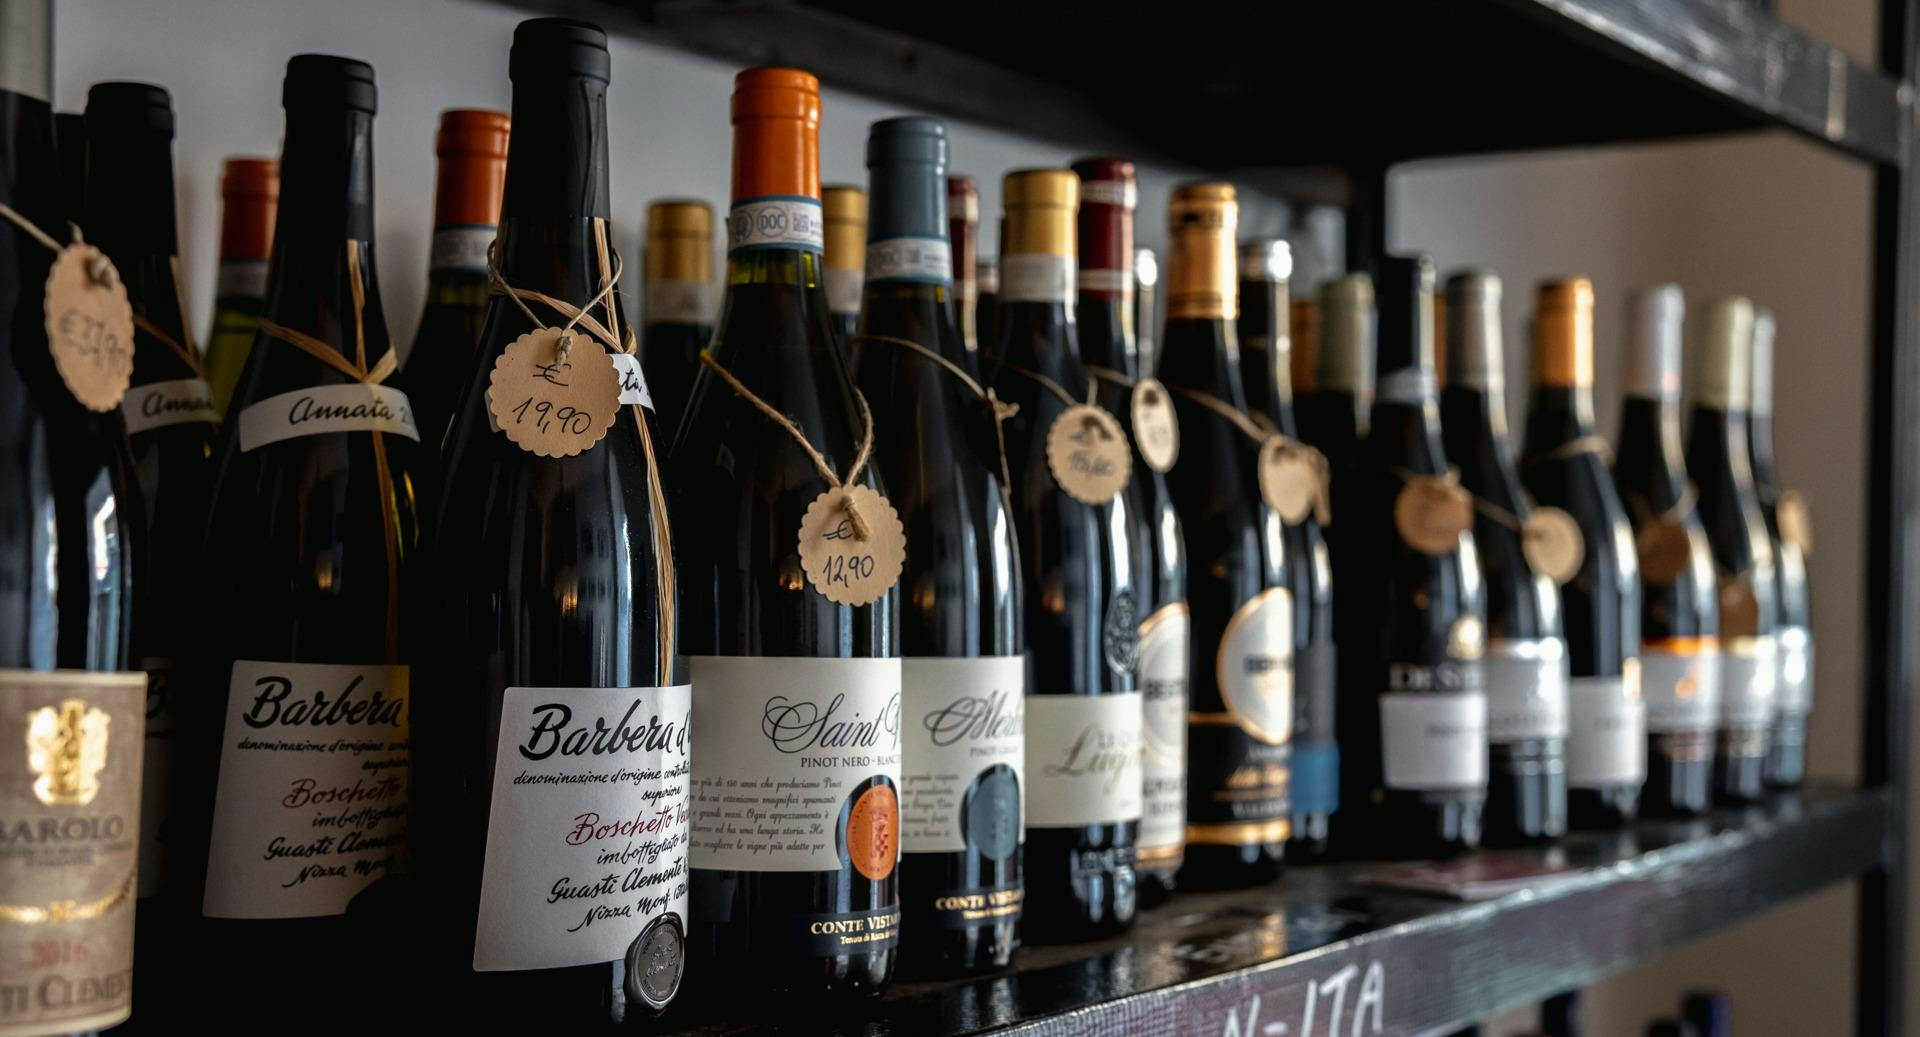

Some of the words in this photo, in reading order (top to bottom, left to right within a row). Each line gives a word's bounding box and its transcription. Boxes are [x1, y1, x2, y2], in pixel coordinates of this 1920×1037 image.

[761, 214, 784, 230] DOC
[289, 397, 395, 425] Annata
[512, 396, 592, 435] 19,90
[823, 555, 875, 588] 12,90
[243, 675, 404, 728] Barbera
[518, 698, 675, 761] Barbera
[762, 693, 885, 754] Saint
[801, 756, 839, 768] PINOT
[842, 756, 870, 767] NERO
[513, 770, 608, 786] denominazione
[610, 768, 662, 786] d'origine
[761, 777, 773, 788] che
[641, 784, 683, 808] superiore
[762, 793, 798, 808] magnifici
[565, 805, 675, 846] Boschetto
[746, 808, 767, 823] Ogni
[727, 823, 736, 833] ha
[757, 824, 778, 839] lunga
[263, 837, 337, 861] Guasti
[597, 833, 680, 865] imbottigliato
[747, 841, 766, 854] vigne
[769, 841, 783, 855] più
[786, 839, 809, 850] adatte
[813, 844, 824, 855] per
[547, 876, 621, 904] Guasti
[621, 855, 683, 894] Clemente
[567, 905, 632, 933] Nizza
[811, 919, 864, 934] CONTE
